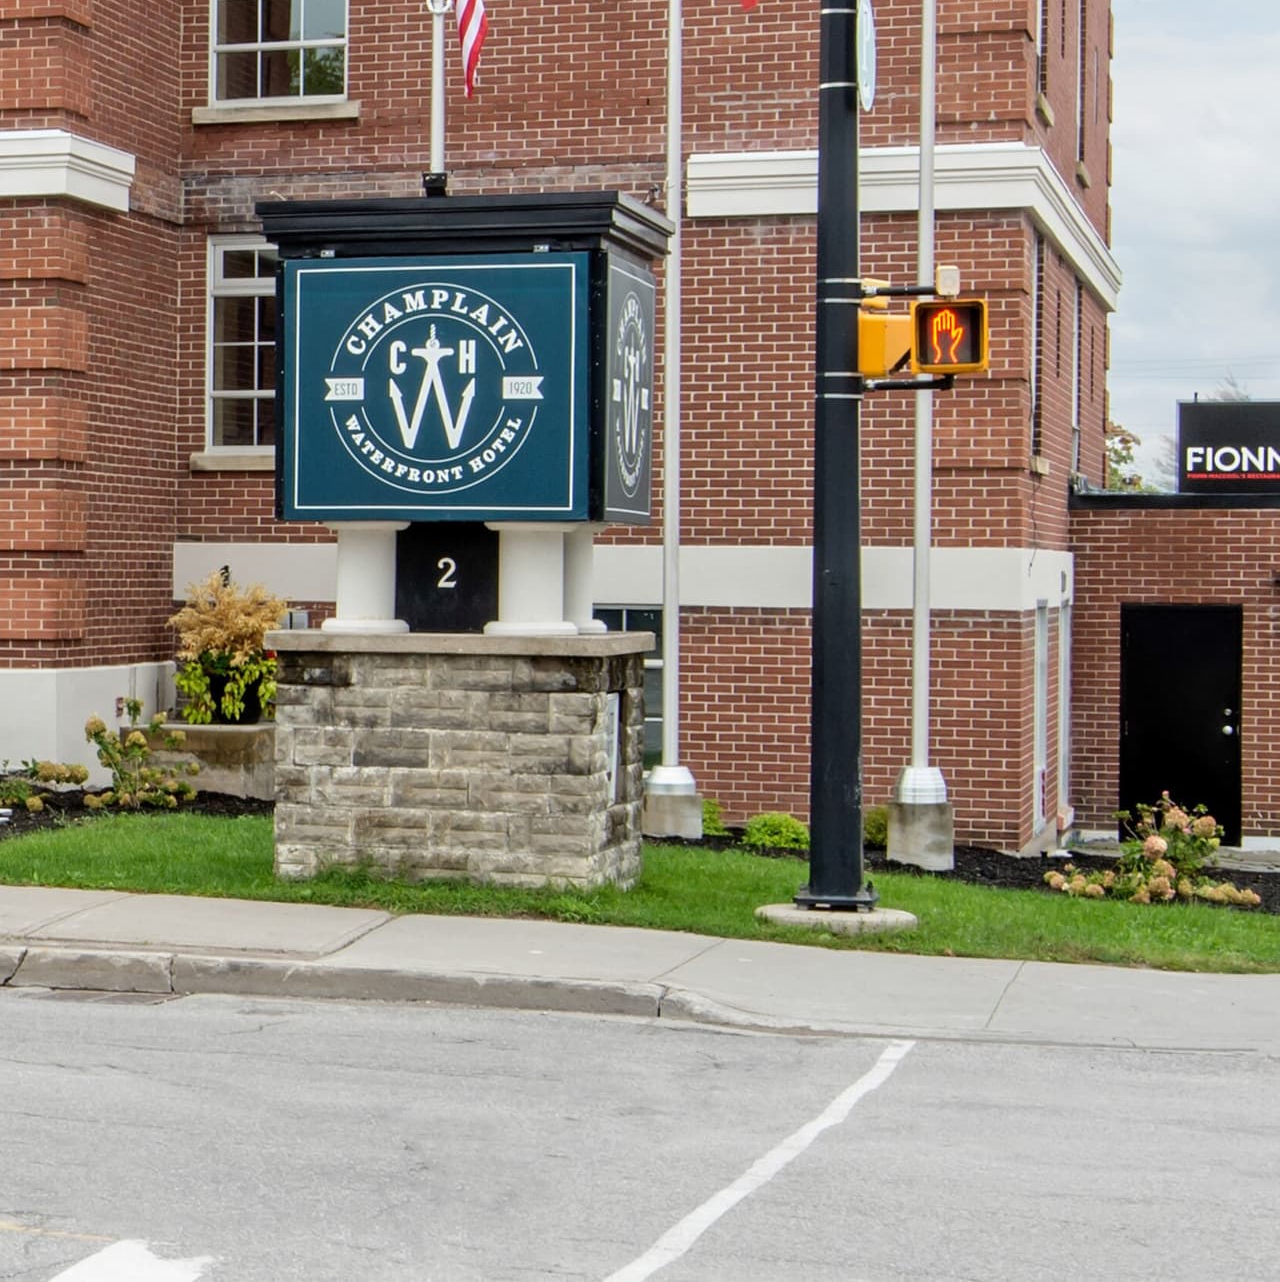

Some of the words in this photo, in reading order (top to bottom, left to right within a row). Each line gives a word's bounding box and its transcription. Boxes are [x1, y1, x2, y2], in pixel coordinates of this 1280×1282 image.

[346, 289, 524, 355] CHAMPLAIN
[389, 339, 408, 375] C
[458, 339, 477, 374] H
[334, 382, 359, 396] ESTD
[509, 381, 533, 395] 1920
[344, 413, 464, 484] WATERFRONT
[468, 417, 523, 473] HOTEL
[437, 557, 458, 588] 2
